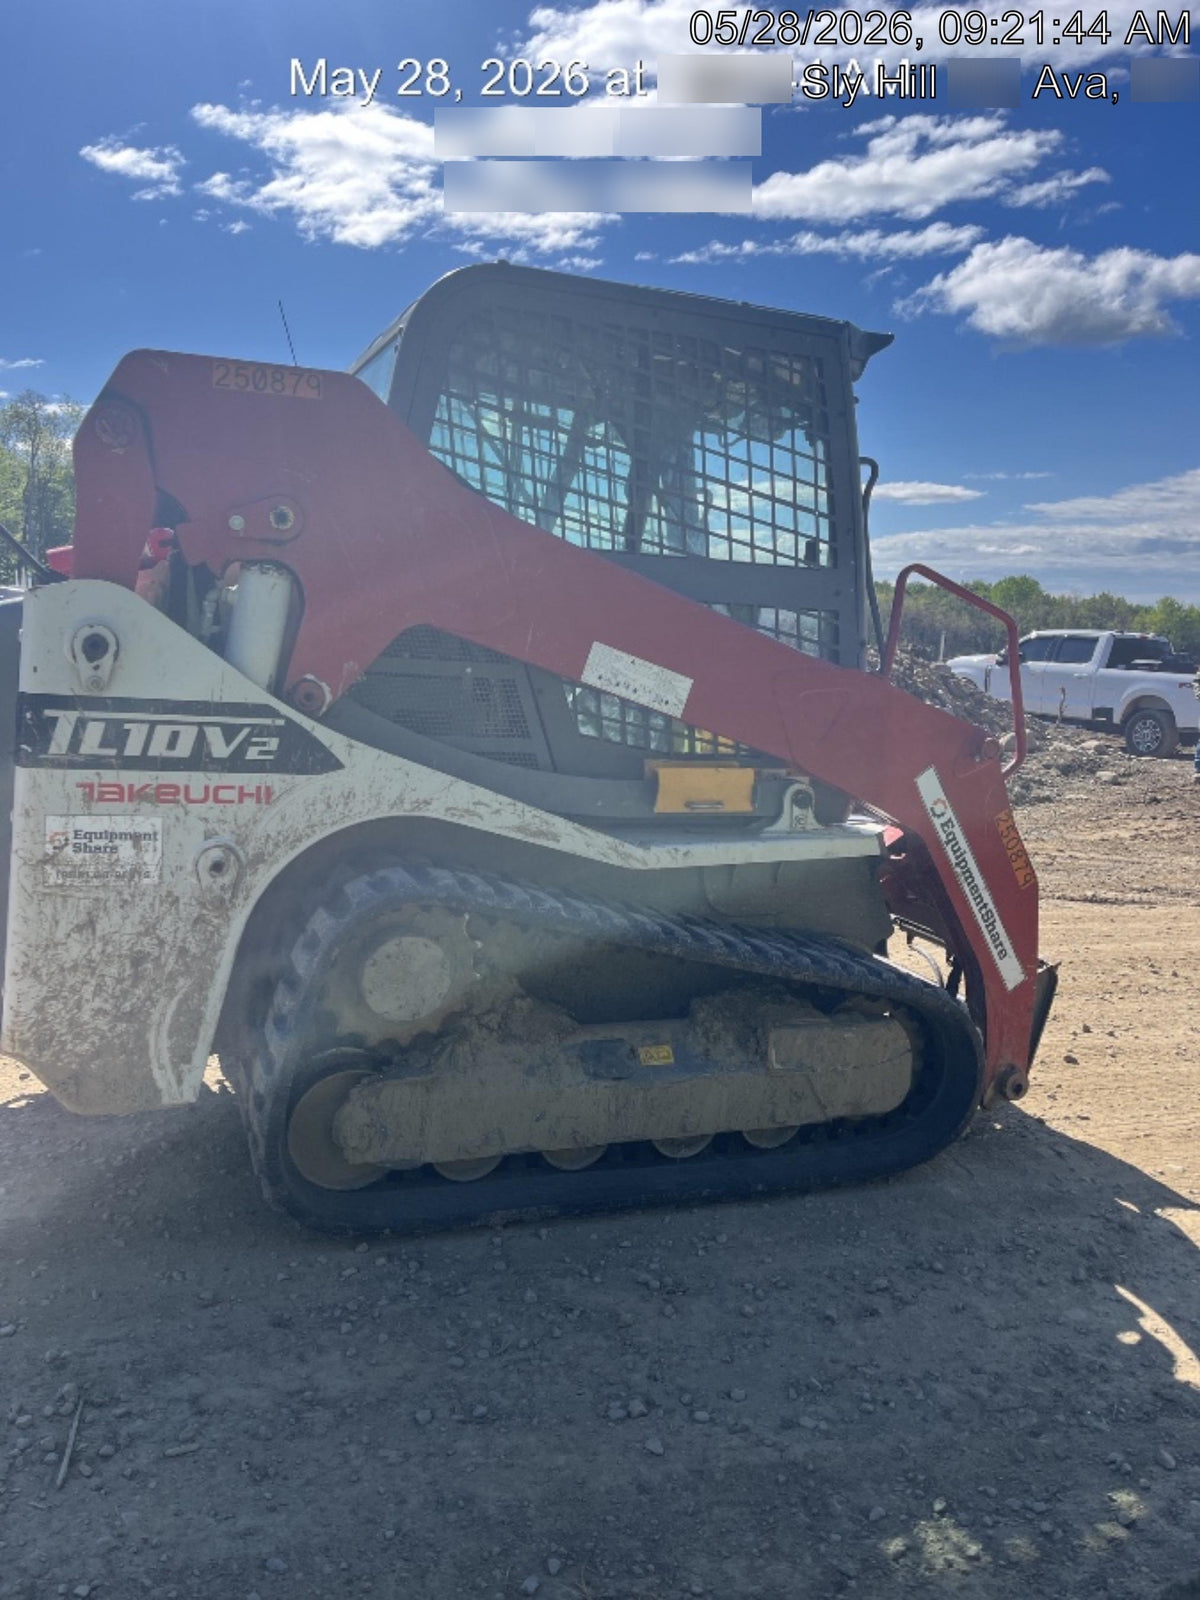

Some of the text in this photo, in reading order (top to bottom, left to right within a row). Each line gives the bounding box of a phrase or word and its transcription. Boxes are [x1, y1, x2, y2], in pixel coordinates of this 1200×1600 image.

[214, 363, 322, 397] 250879
[72, 842, 118, 854] Share
[73, 829, 159, 843] Equipment
[940, 816, 1008, 961] EquipmentShare
